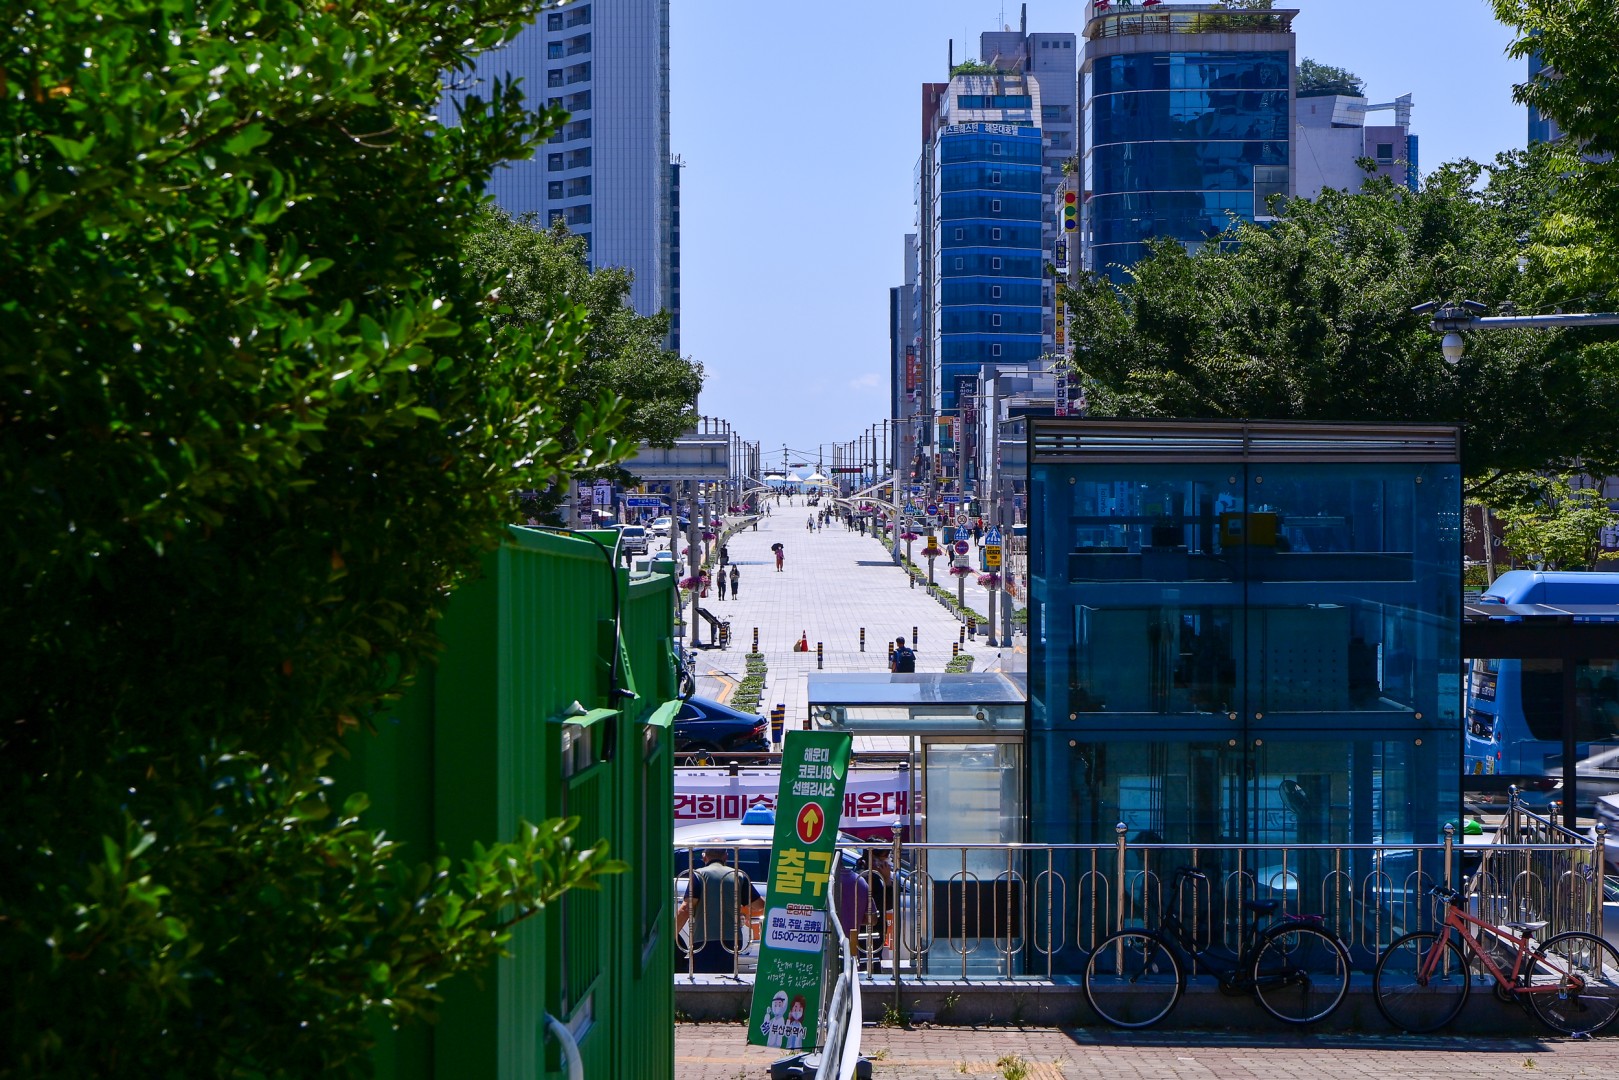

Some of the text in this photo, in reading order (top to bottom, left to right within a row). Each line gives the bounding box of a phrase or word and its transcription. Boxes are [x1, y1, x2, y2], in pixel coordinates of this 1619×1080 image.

[804, 747, 830, 763] 해운대
[798, 764, 832, 780] 코로나19
[792, 781, 836, 797] 선별검사소
[775, 848, 832, 897] 출구
[772, 916, 822, 932] 평일, 주말, 공휴일
[772, 931, 820, 944] (15:00~21:00)
[771, 1024, 808, 1040] 부산광역시
